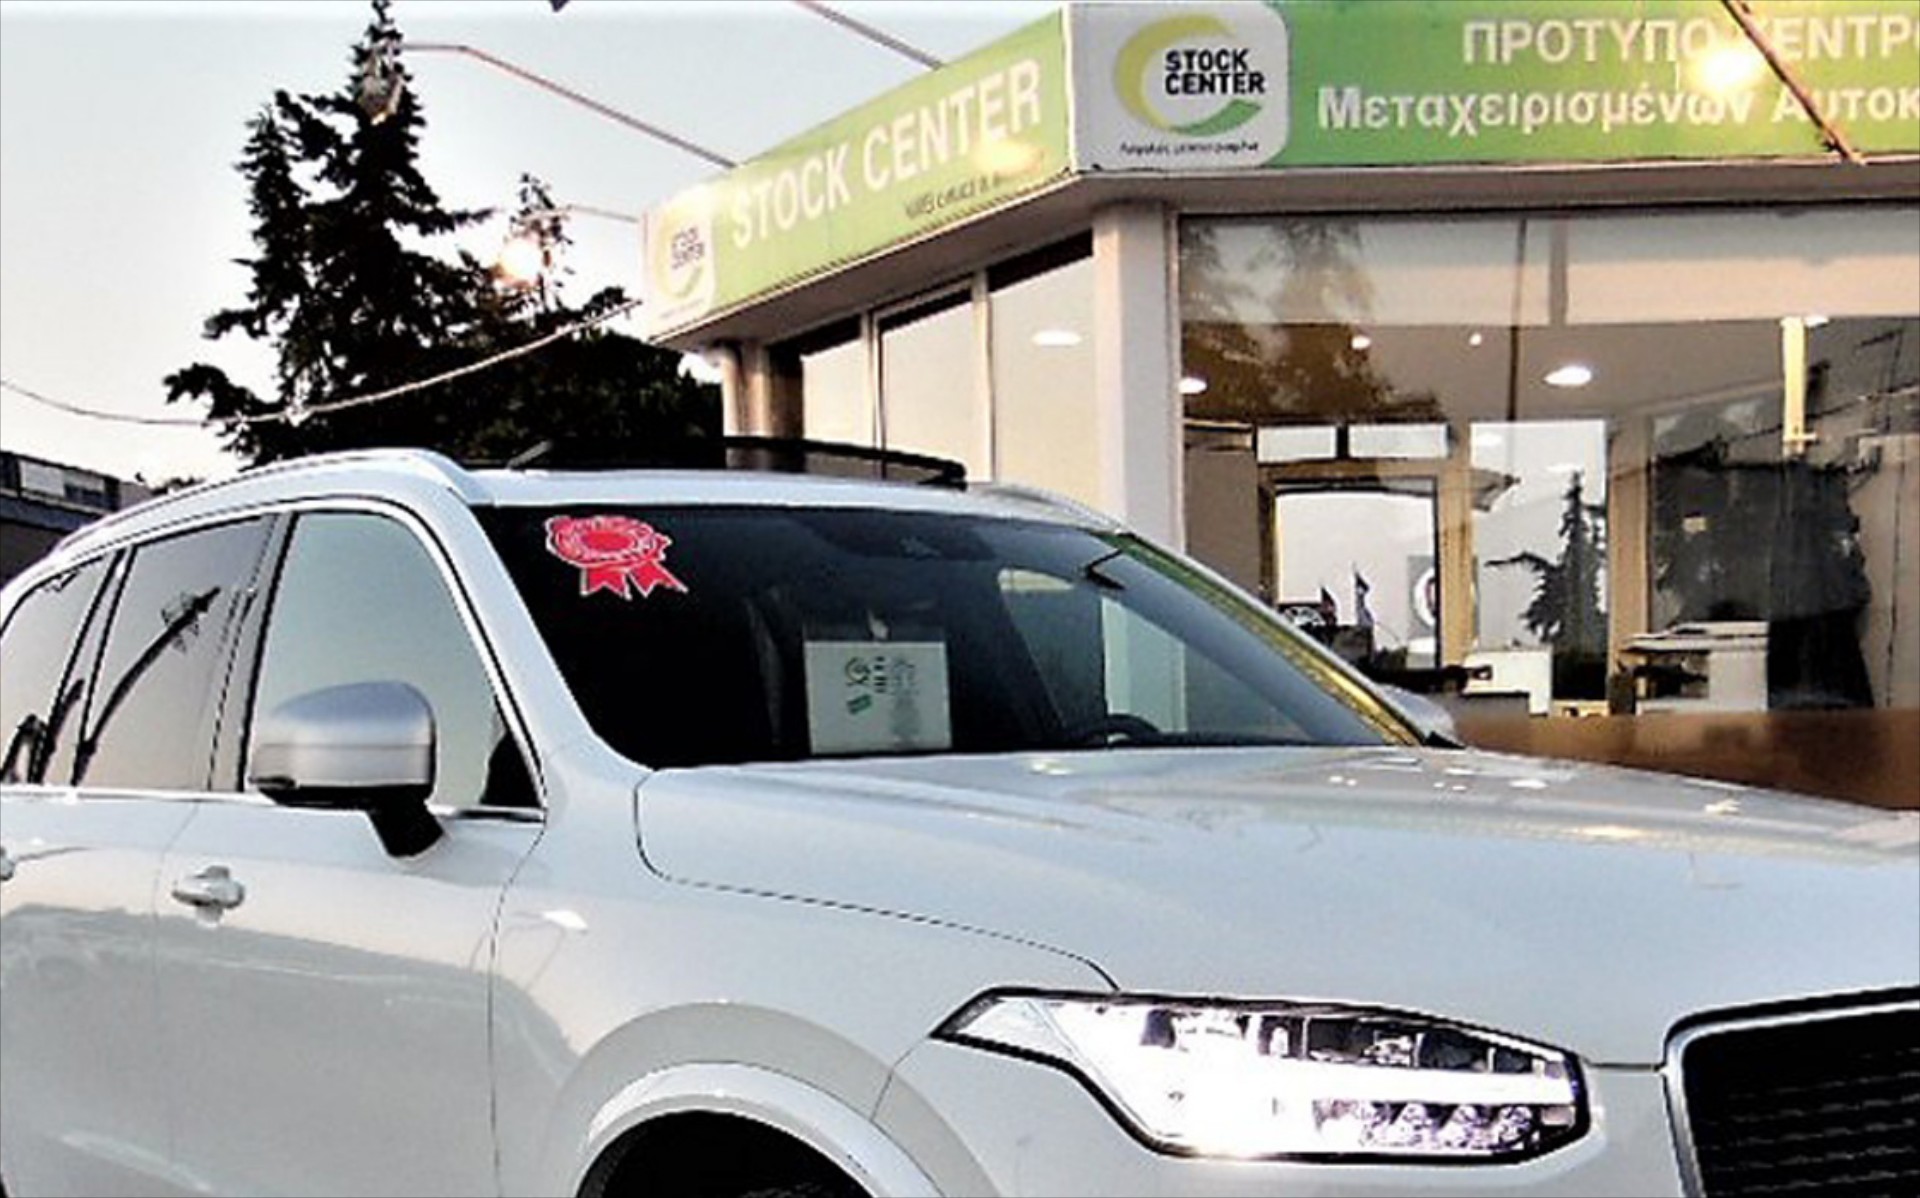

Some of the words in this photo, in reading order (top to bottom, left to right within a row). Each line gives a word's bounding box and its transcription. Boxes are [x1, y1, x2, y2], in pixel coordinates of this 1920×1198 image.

[1164, 49, 1249, 71] STOCK
[1165, 72, 1266, 95] CENTER
[731, 141, 851, 249] STOCK
[862, 57, 1041, 191] CENTER
